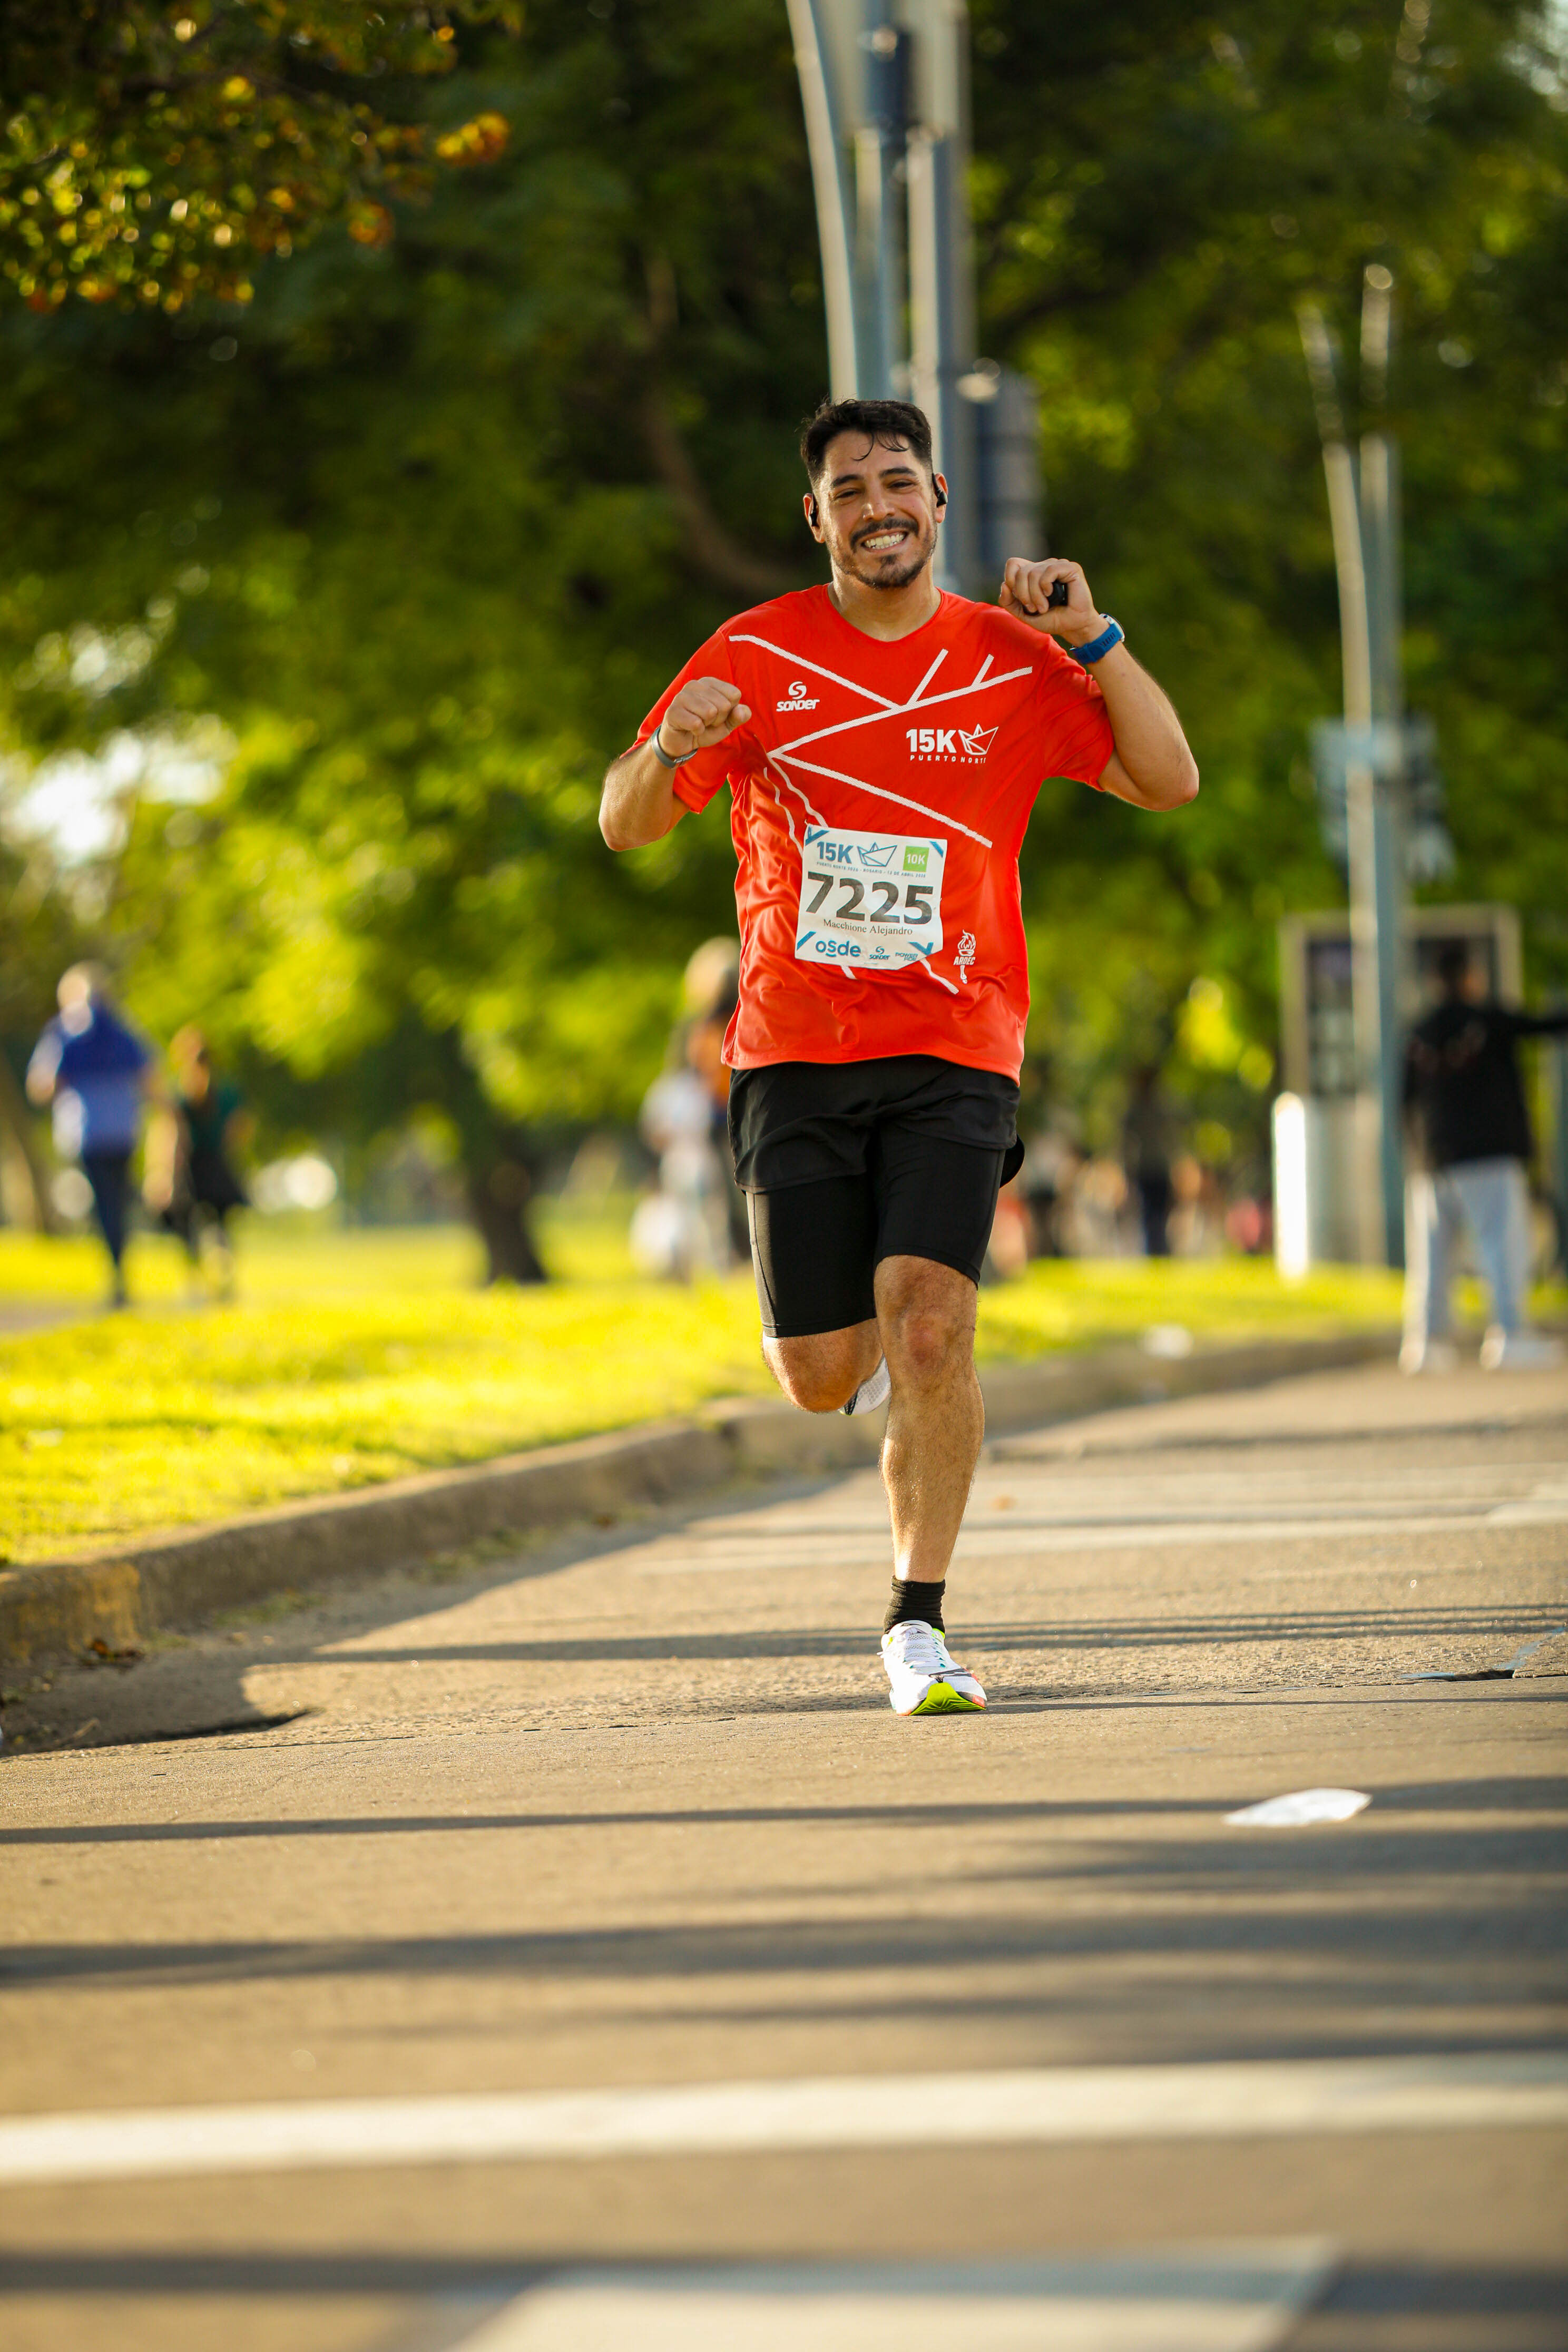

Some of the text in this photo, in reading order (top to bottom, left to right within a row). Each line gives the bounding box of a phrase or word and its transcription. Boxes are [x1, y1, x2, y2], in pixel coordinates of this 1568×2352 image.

[906, 729, 957, 753] 15K
[817, 841, 854, 864] 15K
[907, 854, 926, 865] 10K
[806, 871, 934, 925] 7225
[824, 918, 913, 936] Macchione Alejandro
[816, 940, 861, 957] osde
[953, 956, 976, 965] ARDEC
